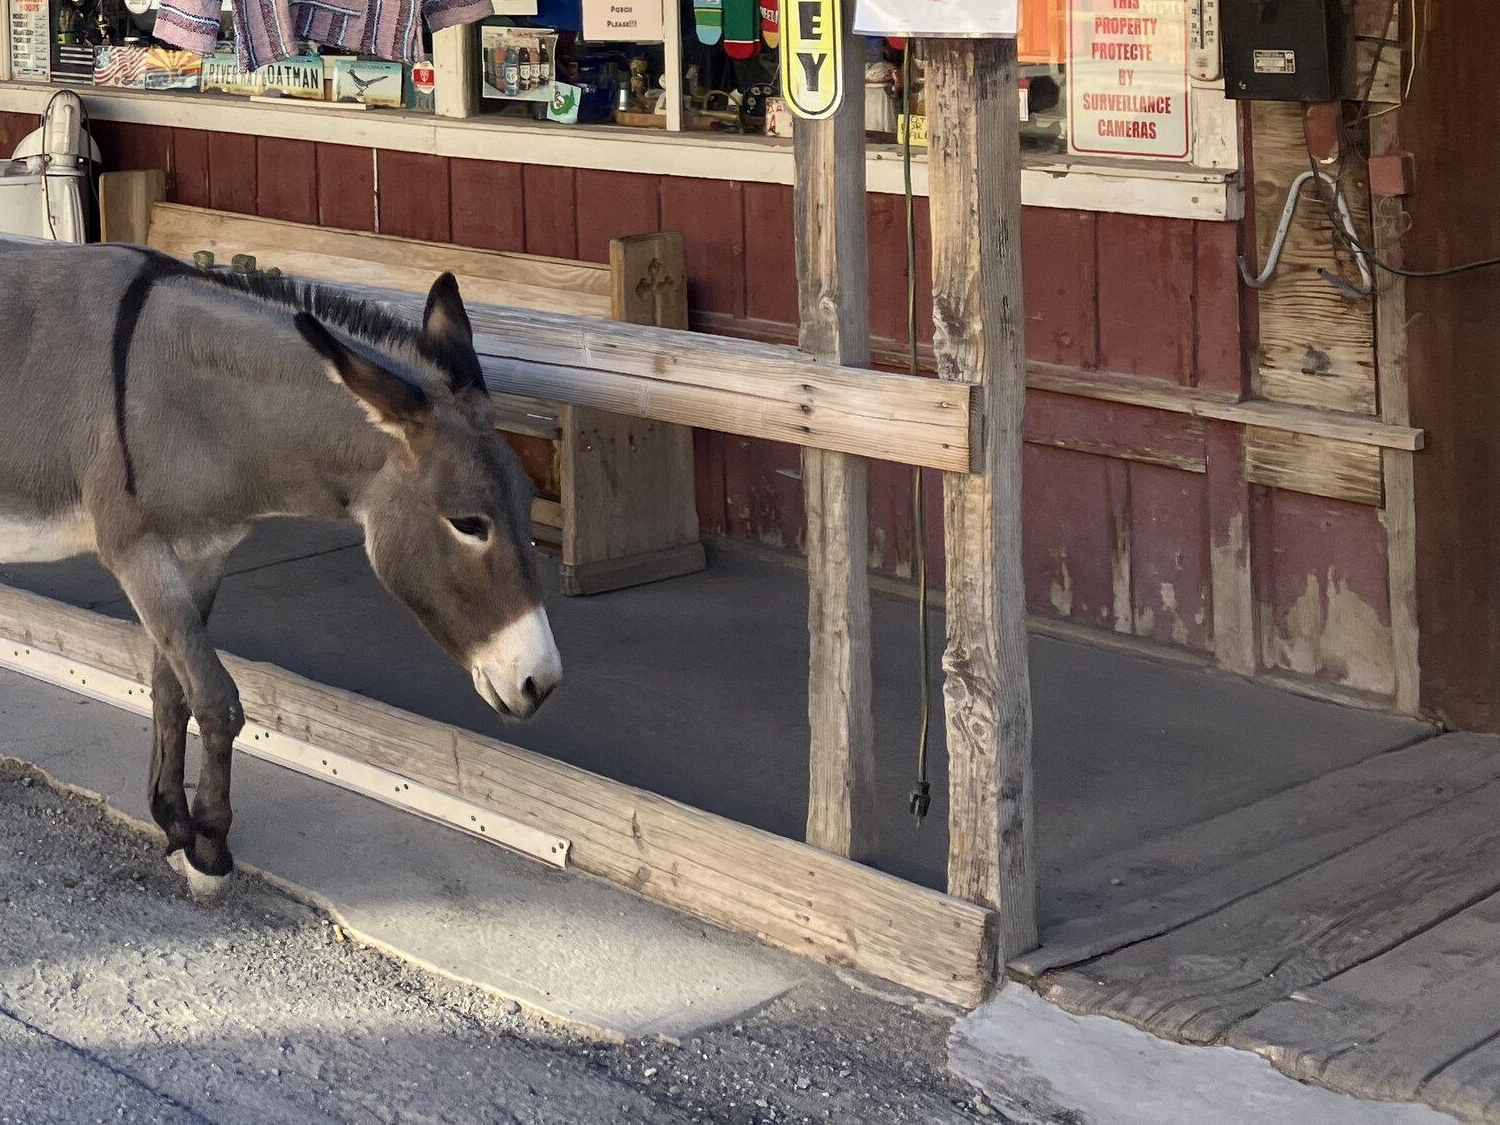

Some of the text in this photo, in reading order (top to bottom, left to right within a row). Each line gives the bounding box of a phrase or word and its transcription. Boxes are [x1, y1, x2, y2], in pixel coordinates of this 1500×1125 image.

[611, 5, 633, 13] PORCH
[1094, 17, 1158, 36] PROPERTY
[209, 63, 238, 85] RIVER
[267, 64, 319, 89] OATMAN
[1118, 69, 1134, 86] BY
[1083, 92, 1172, 114] SURVEILLANCE
[1097, 119, 1157, 140] CAMERAS
